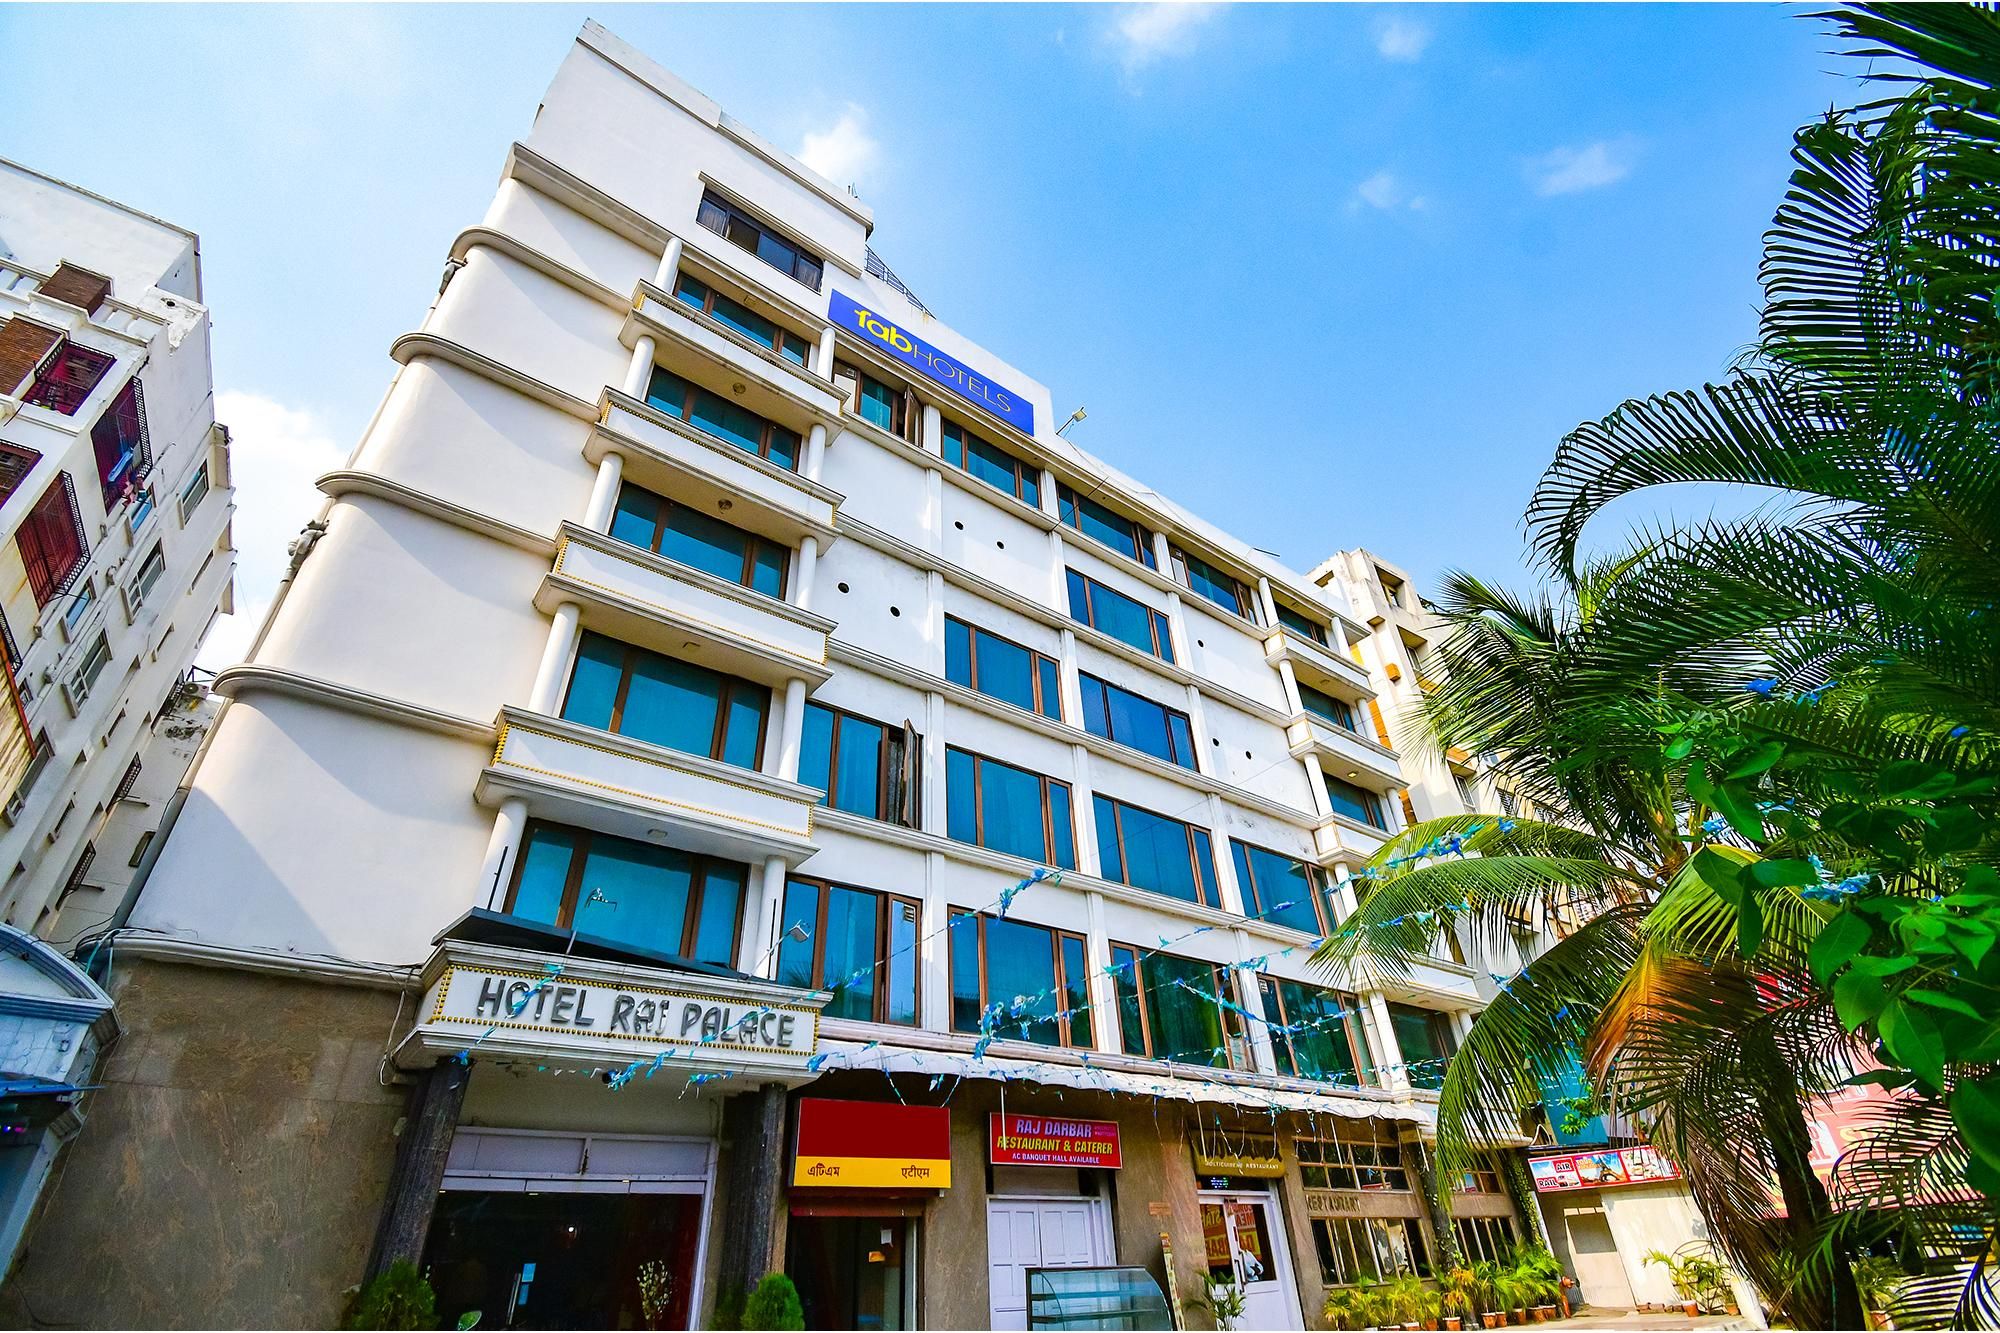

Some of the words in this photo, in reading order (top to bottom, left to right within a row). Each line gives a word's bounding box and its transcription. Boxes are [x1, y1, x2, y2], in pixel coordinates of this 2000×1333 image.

[476, 977, 595, 1026] HOTEL
[610, 994, 669, 1036] RAJ
[680, 1002, 795, 1047] PALACE
[1016, 1119, 1041, 1135] RAJ
[1044, 1121, 1092, 1138] DARBAR
[997, 1136, 1061, 1152] RESTAURANT
[1063, 1140, 1071, 1152] &
[1074, 1140, 1113, 1154] CATERER
[1022, 1153, 1051, 1161] BANQUET
[1052, 1154, 1067, 1162] HALL
[1069, 1155, 1100, 1164] AVAILABLE
[807, 1162, 840, 1177] এটিএম
[901, 1164, 930, 1179] एटीएम
[1556, 1162, 1571, 1171] AIR
[1538, 1179, 1558, 1188] RAIL
